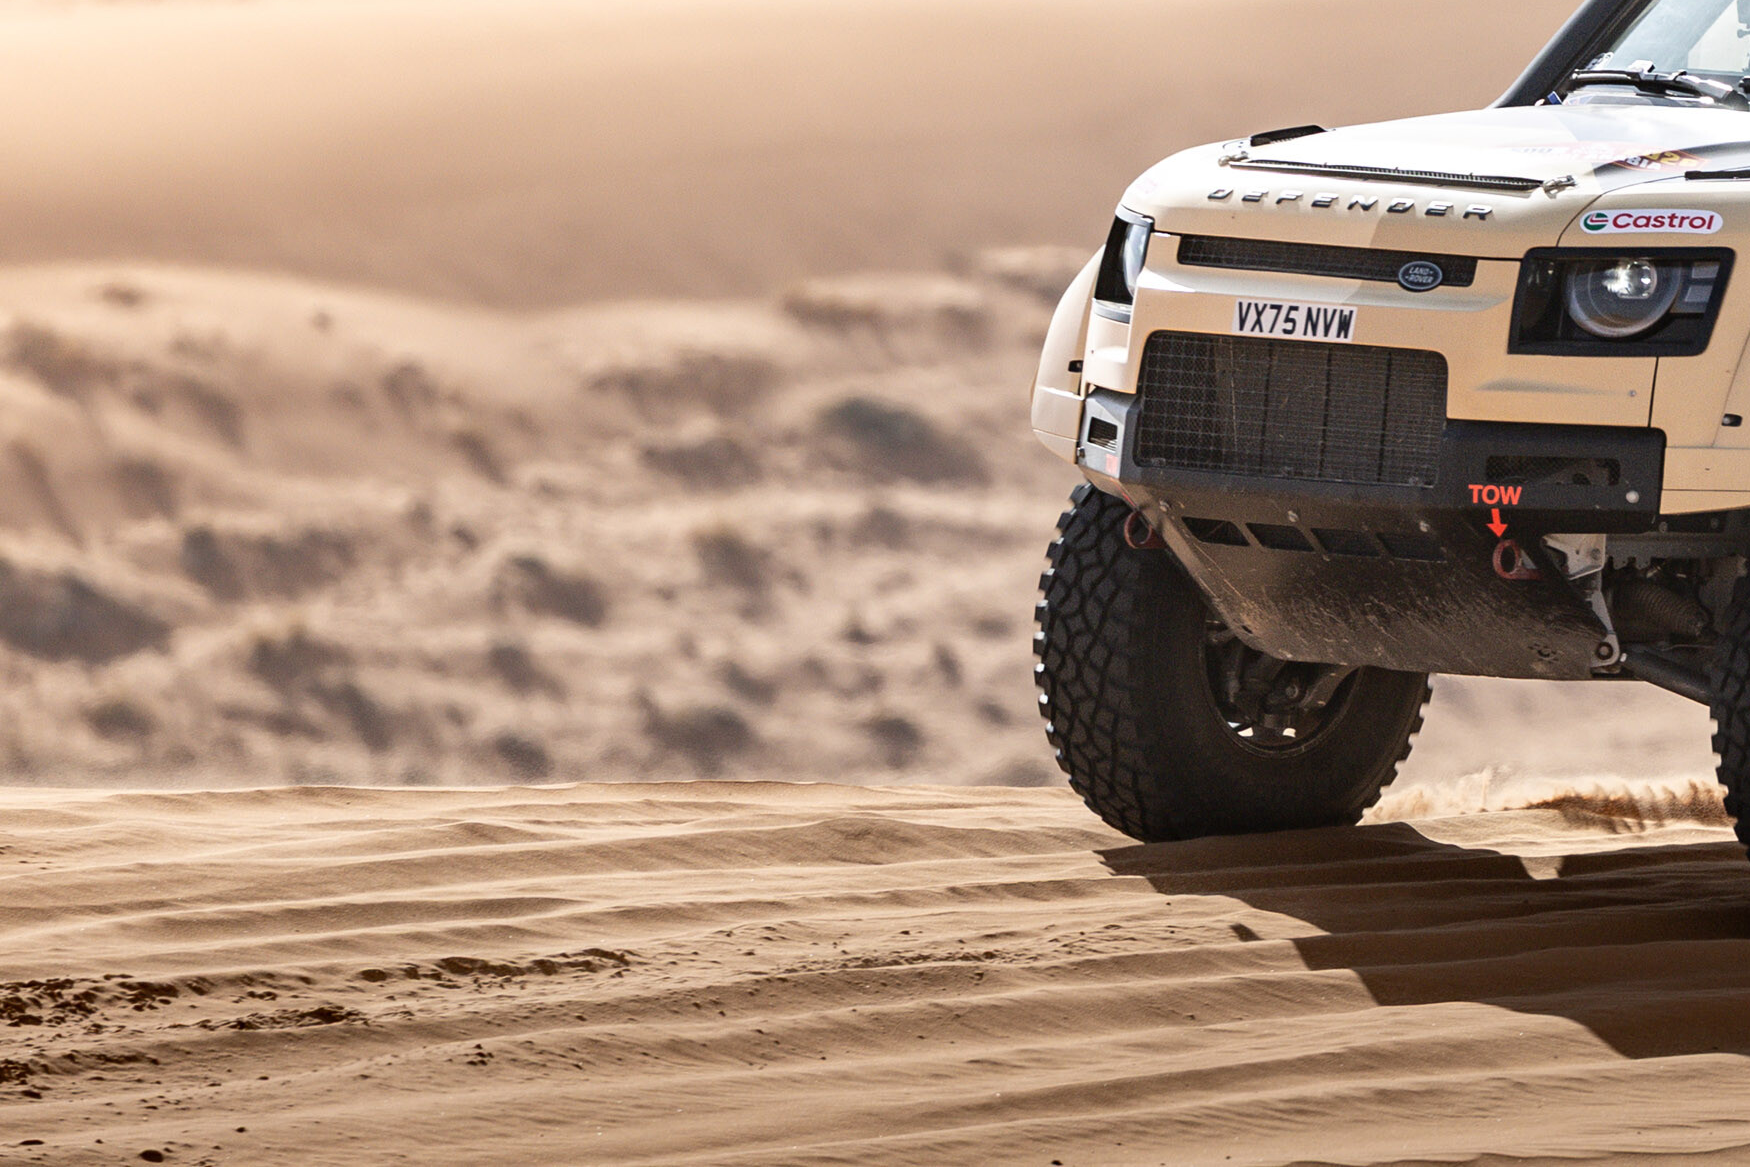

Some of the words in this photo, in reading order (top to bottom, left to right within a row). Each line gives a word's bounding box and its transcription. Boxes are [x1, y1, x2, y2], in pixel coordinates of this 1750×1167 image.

[1207, 188, 1493, 220] DEFENDER
[1612, 212, 1715, 230] Castrol
[1238, 301, 1299, 335] VX75
[1303, 306, 1354, 339] NVW
[1468, 484, 1523, 505] TOW
